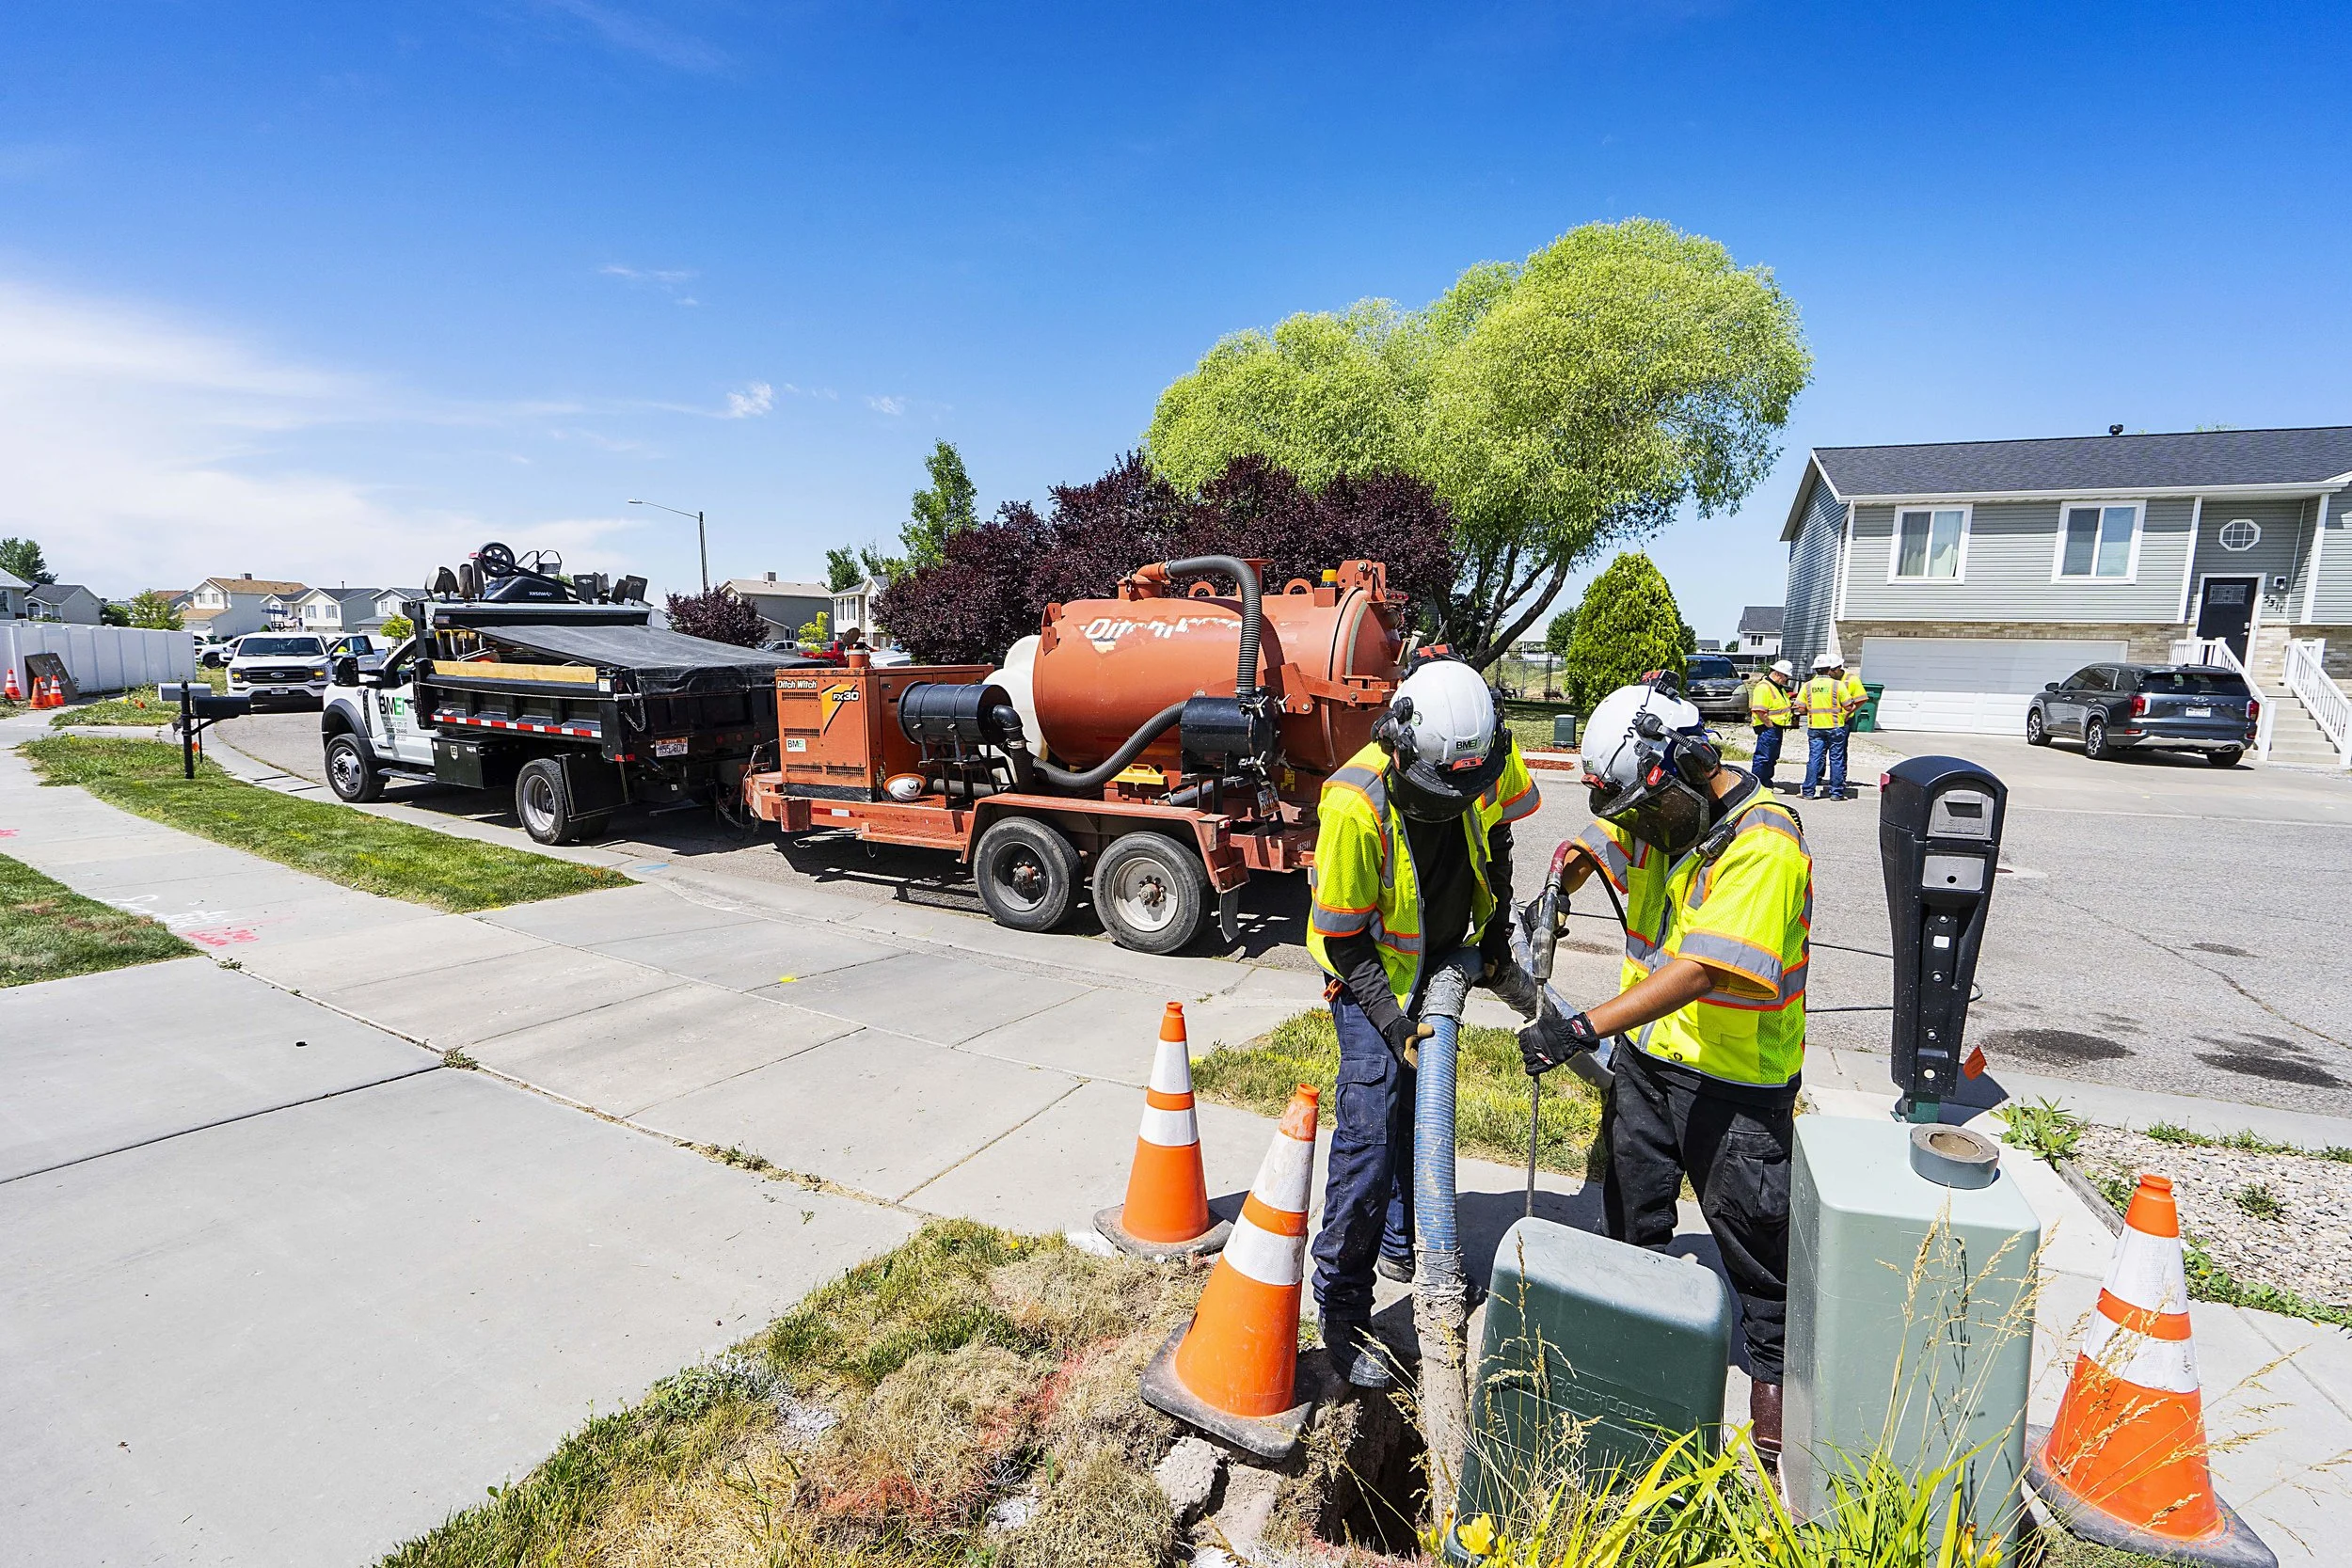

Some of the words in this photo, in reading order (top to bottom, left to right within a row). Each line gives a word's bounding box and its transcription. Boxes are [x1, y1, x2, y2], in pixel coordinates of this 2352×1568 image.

[777, 680, 796, 689] Ditch
[797, 680, 818, 689] Witch
[833, 690, 860, 702] FX30
[379, 696, 405, 715] BMEI
[787, 739, 804, 749] BMEI
[1455, 738, 1478, 750] BMEI
